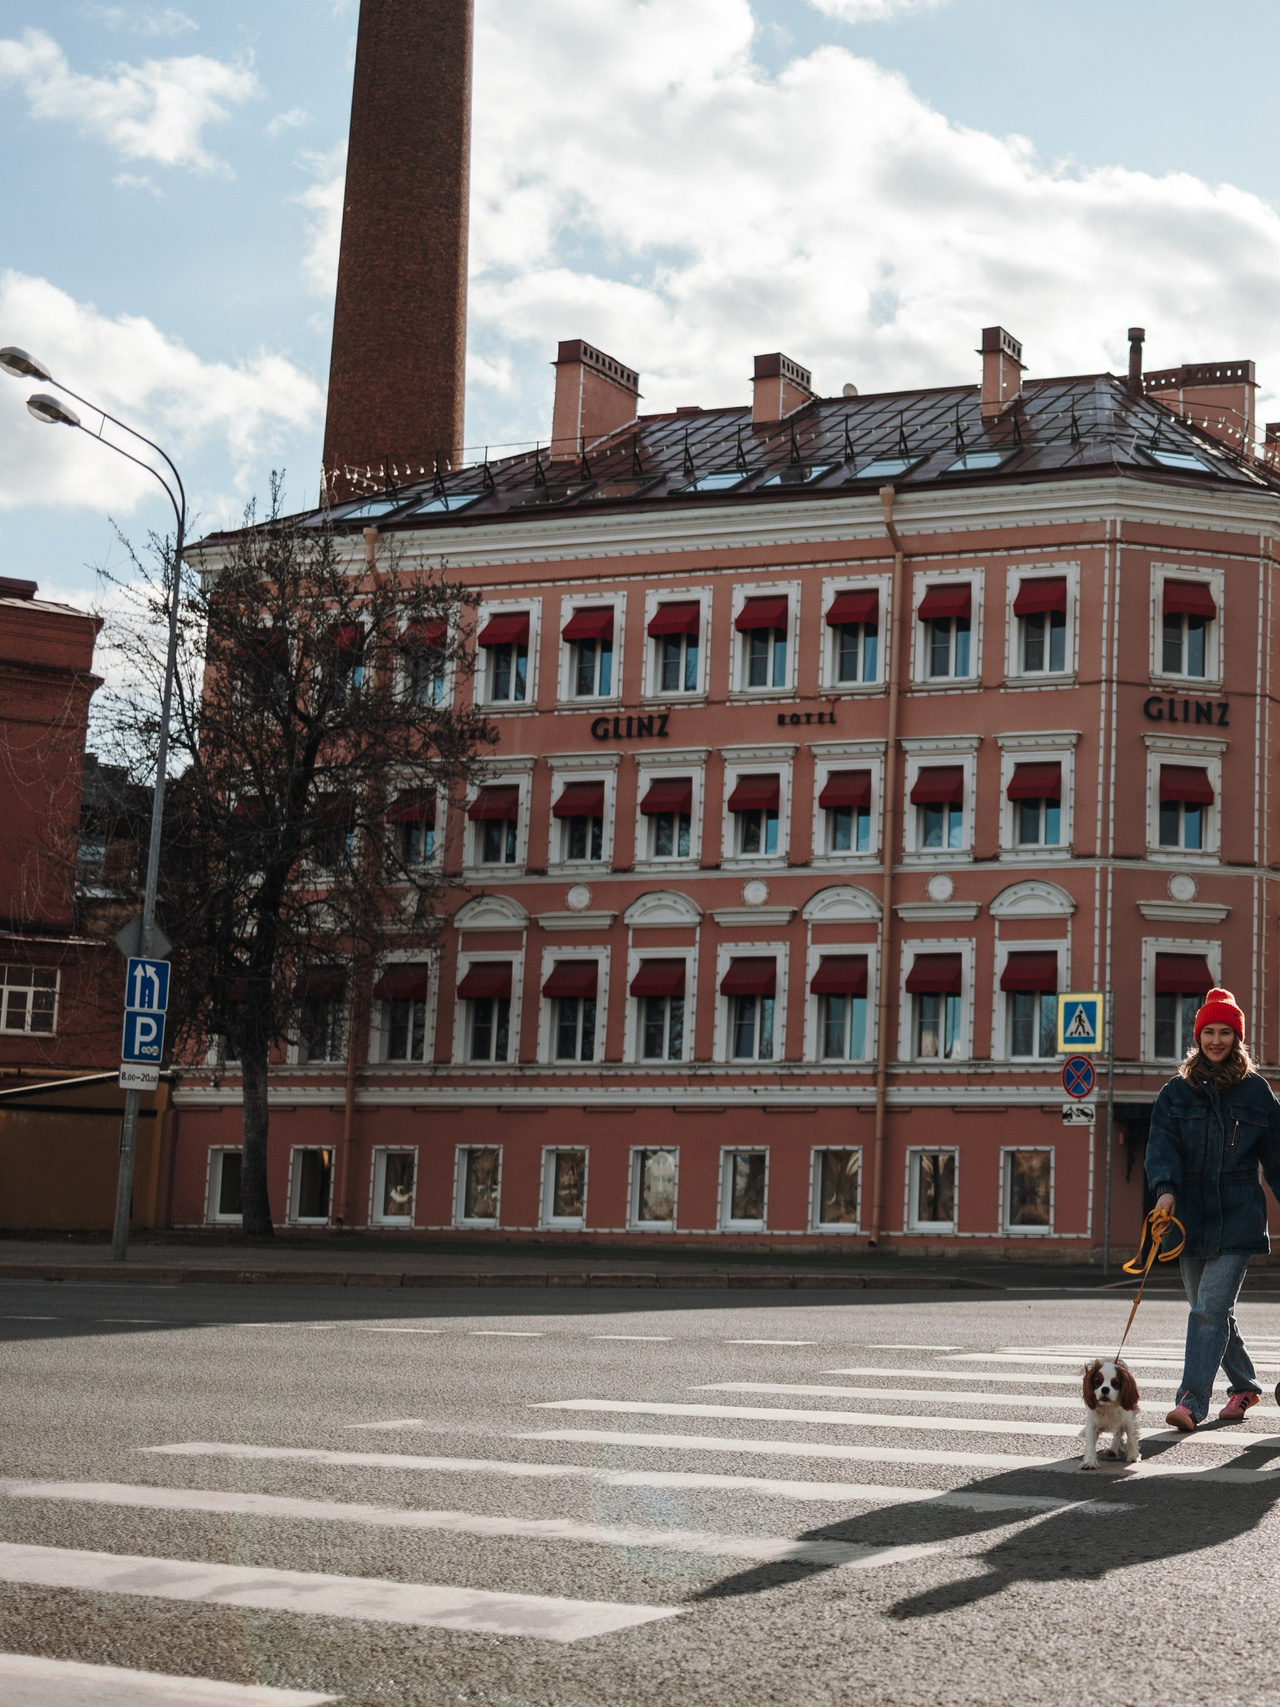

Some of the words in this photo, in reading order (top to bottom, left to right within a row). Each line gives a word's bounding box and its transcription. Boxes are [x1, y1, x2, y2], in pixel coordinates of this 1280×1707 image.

[777, 712, 836, 726] HOTEL
[1143, 696, 1229, 726] GLINZ
[591, 714, 669, 740] GLINZ
[134, 1016, 157, 1055] P
